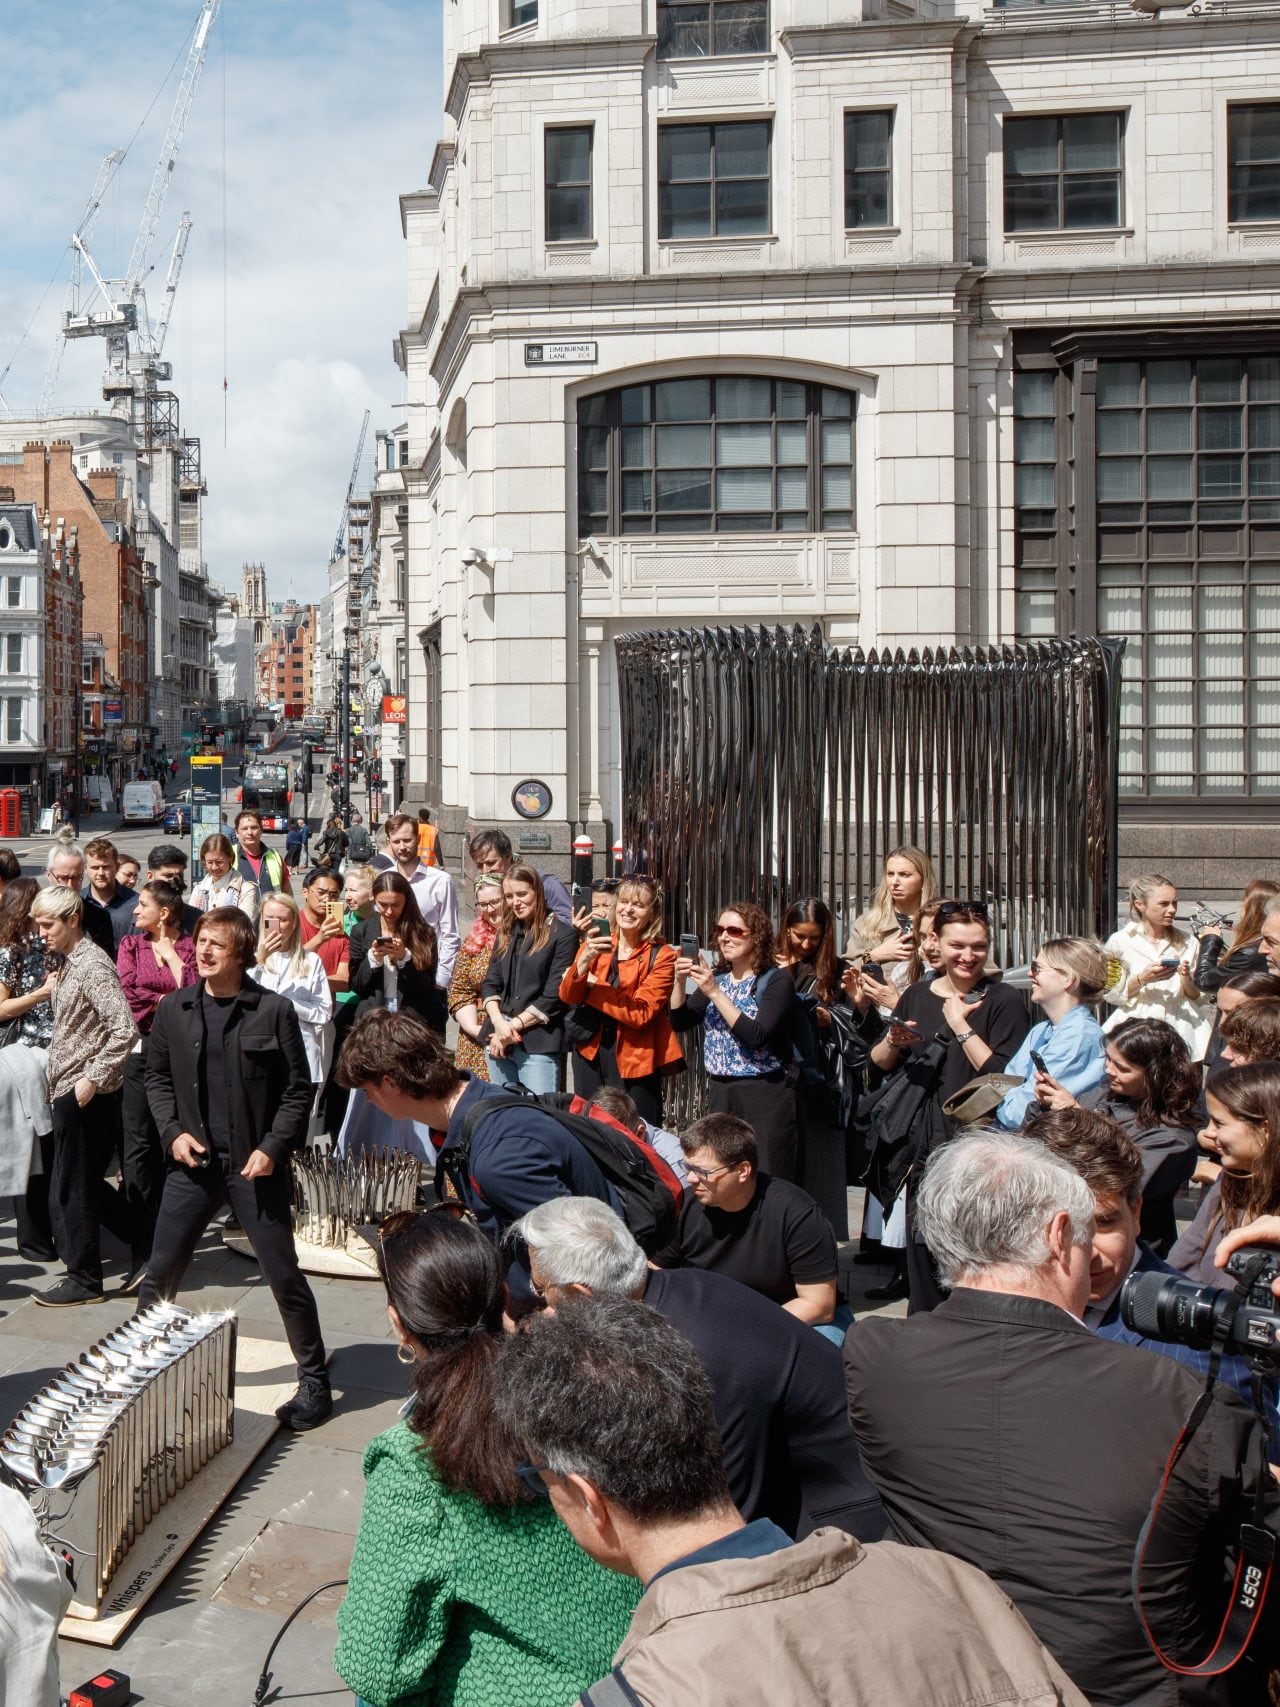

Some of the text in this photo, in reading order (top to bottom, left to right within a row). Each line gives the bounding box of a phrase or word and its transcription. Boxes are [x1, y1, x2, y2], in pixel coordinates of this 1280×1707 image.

[549, 345, 590, 353] LIMEBURNER
[106, 1570, 153, 1612] Whispers
[1240, 1565, 1262, 1609] EOS R
